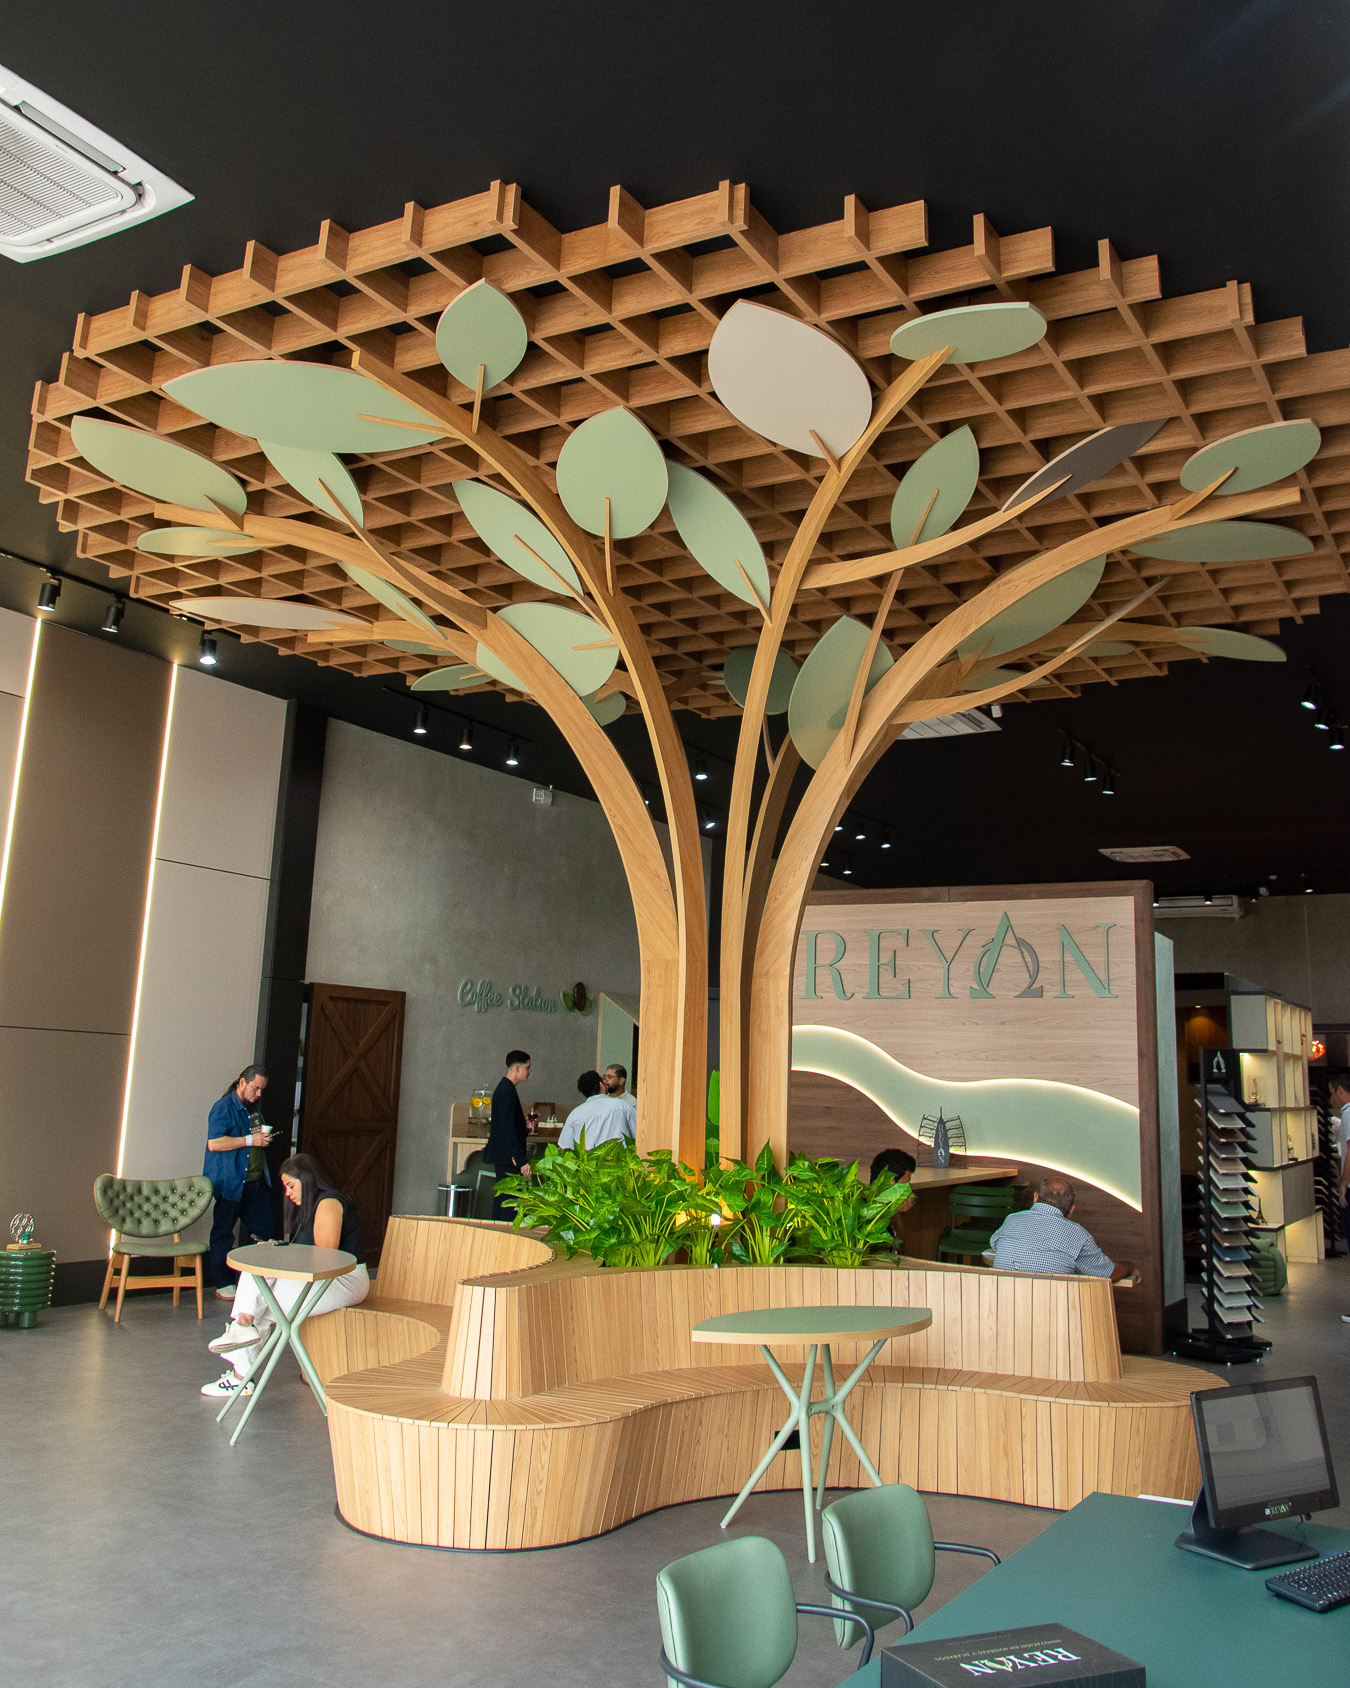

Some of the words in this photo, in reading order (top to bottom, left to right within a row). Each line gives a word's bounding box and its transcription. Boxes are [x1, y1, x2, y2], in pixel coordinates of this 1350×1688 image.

[799, 911, 1118, 1001] REYAN
[457, 978, 503, 1013] Coffee
[507, 984, 558, 1013] Station
[937, 1124, 945, 1164] REYAN
[959, 1646, 1081, 1677] REYAN
